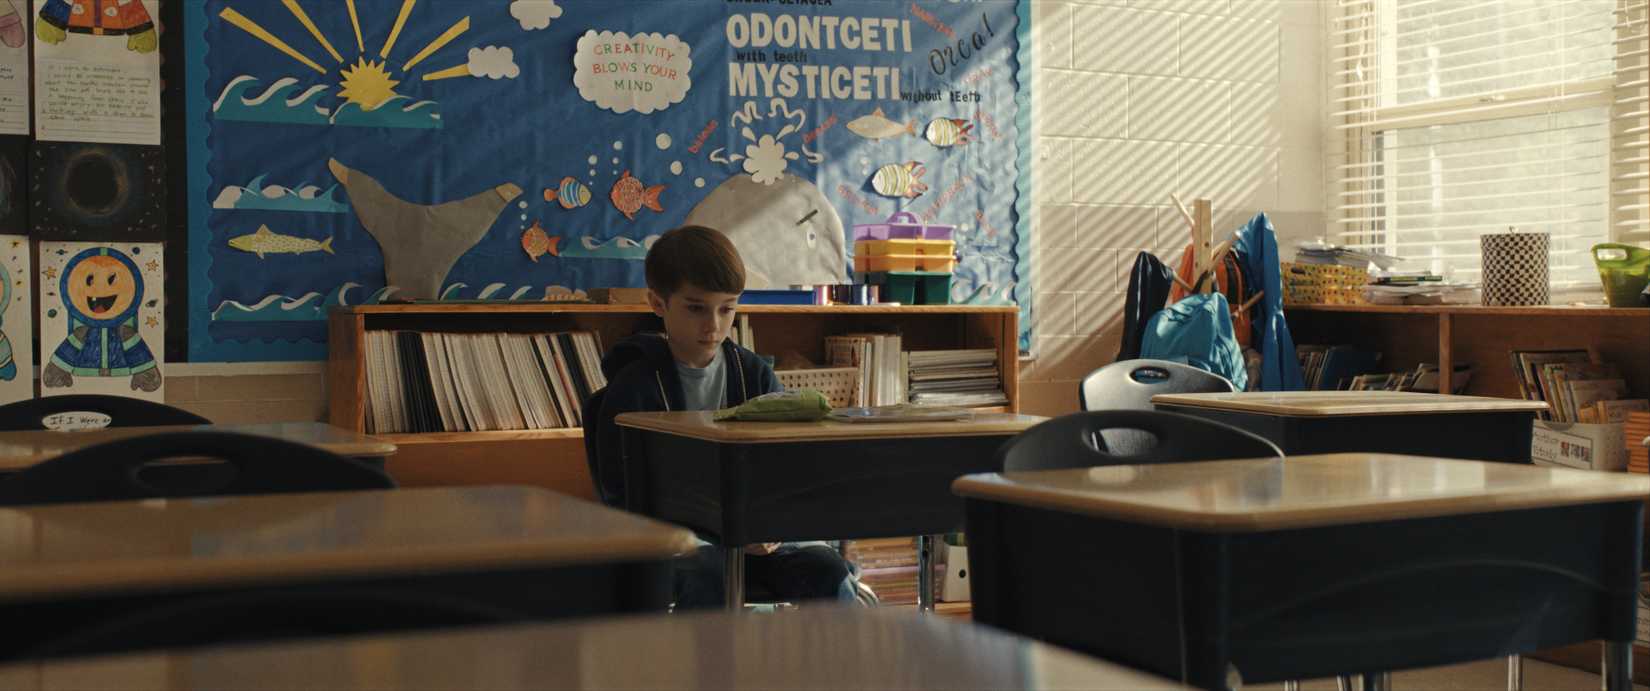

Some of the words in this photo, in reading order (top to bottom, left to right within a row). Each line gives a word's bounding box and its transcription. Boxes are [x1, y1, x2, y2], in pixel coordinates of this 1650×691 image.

[726, 13, 912, 52] ODONTCETI
[593, 43, 674, 61] CREATIVITY
[736, 49, 766, 62] with
[592, 62, 637, 74] BLOWS
[643, 63, 676, 80] YOUR
[614, 80, 653, 92] MIND
[728, 62, 900, 100] MYSTICETI
